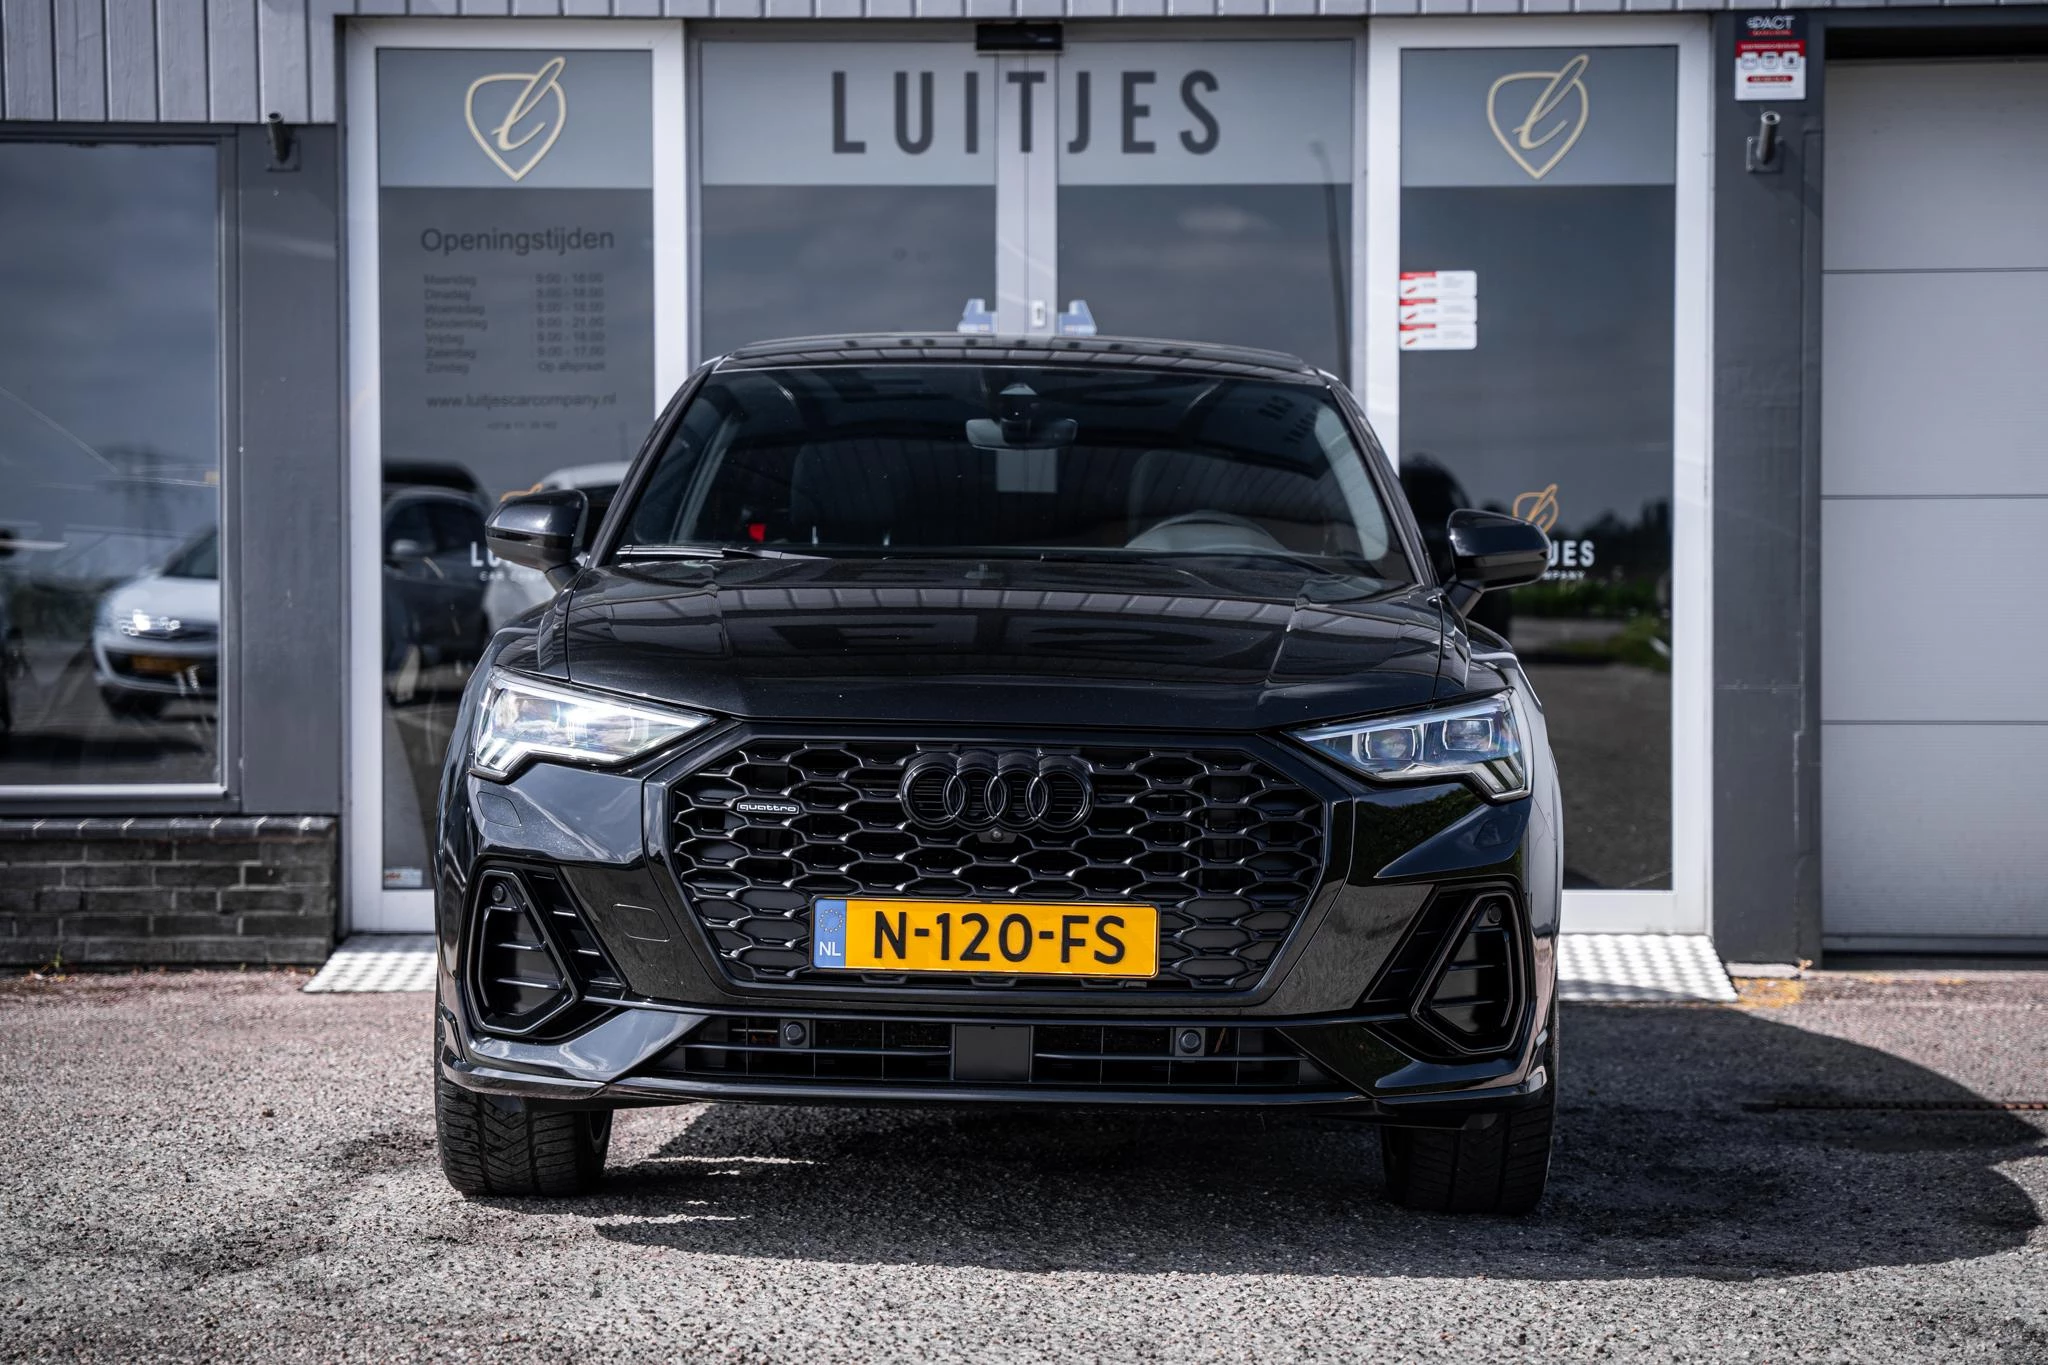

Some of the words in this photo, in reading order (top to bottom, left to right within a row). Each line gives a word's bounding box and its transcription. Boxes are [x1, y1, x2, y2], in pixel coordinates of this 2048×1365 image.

[831, 69, 1221, 155] LUITJES
[421, 227, 615, 256] Openingstijden
[739, 804, 797, 812] quattro
[819, 941, 841, 957] NL
[873, 910, 1127, 965] N-120-FS
